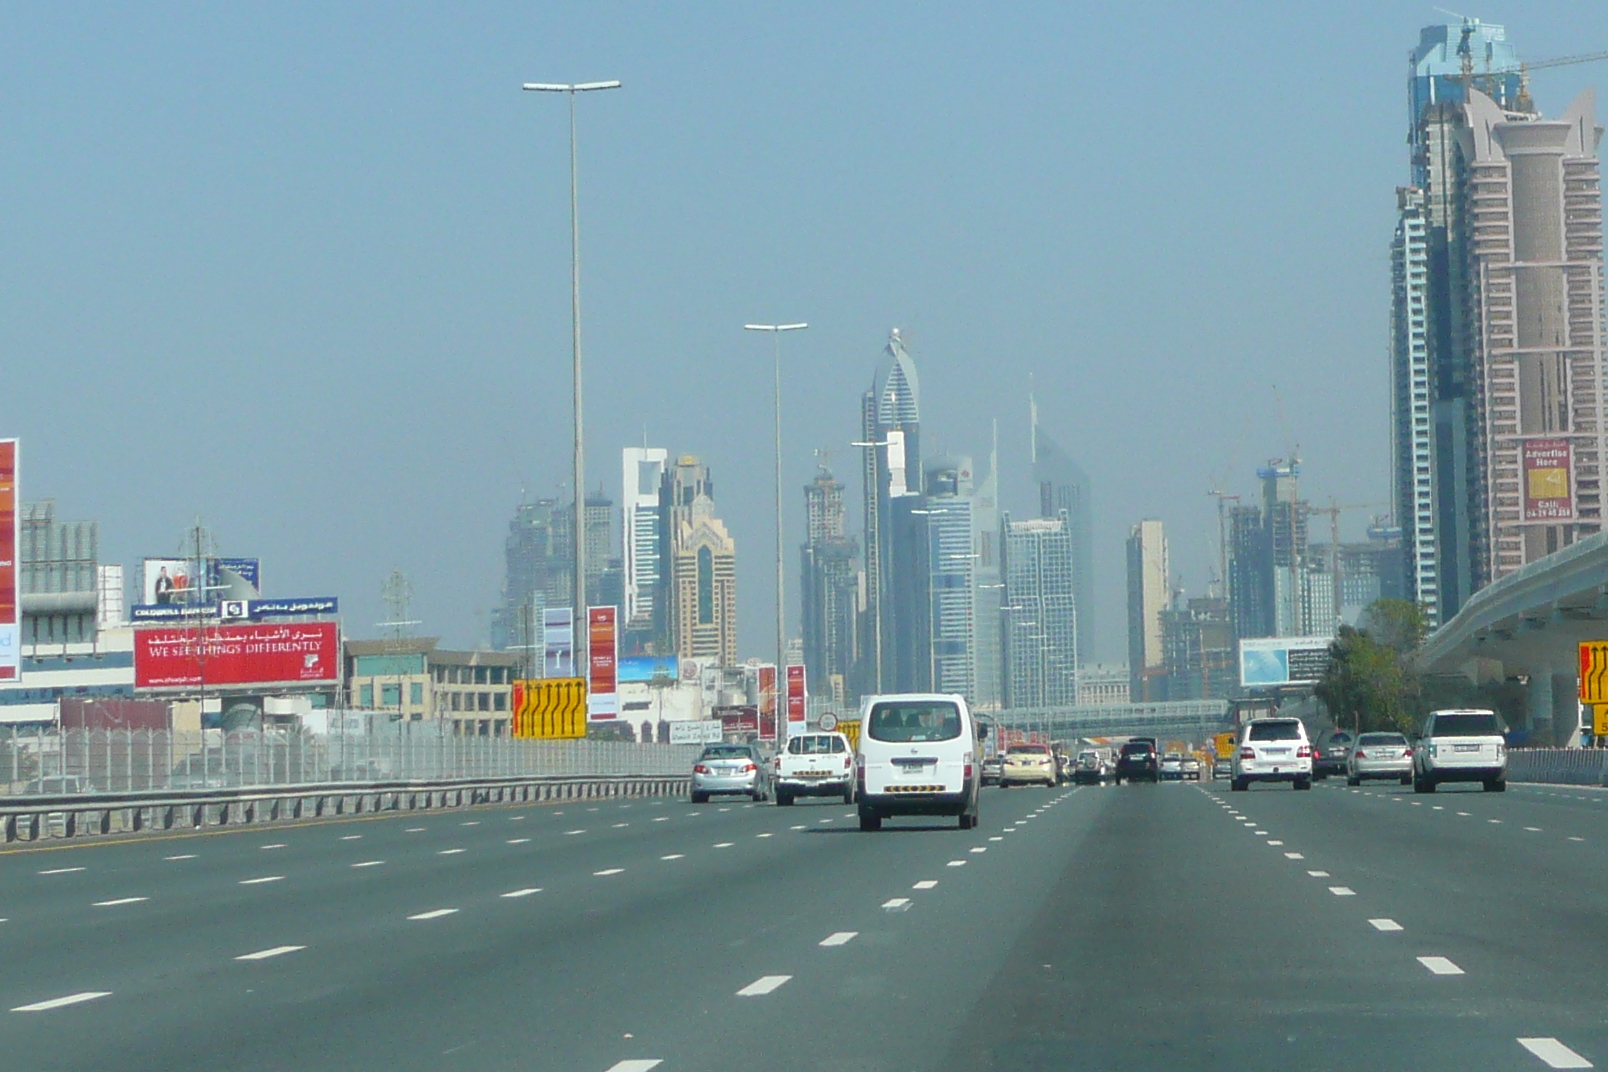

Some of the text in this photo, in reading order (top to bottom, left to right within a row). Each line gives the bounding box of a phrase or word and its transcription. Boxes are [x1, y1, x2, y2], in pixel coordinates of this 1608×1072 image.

[1526, 450, 1567, 458] Advertise
[1536, 458, 1558, 466] Here
[150, 640, 323, 658] WE SEE THINGS DIFFERENTLY
